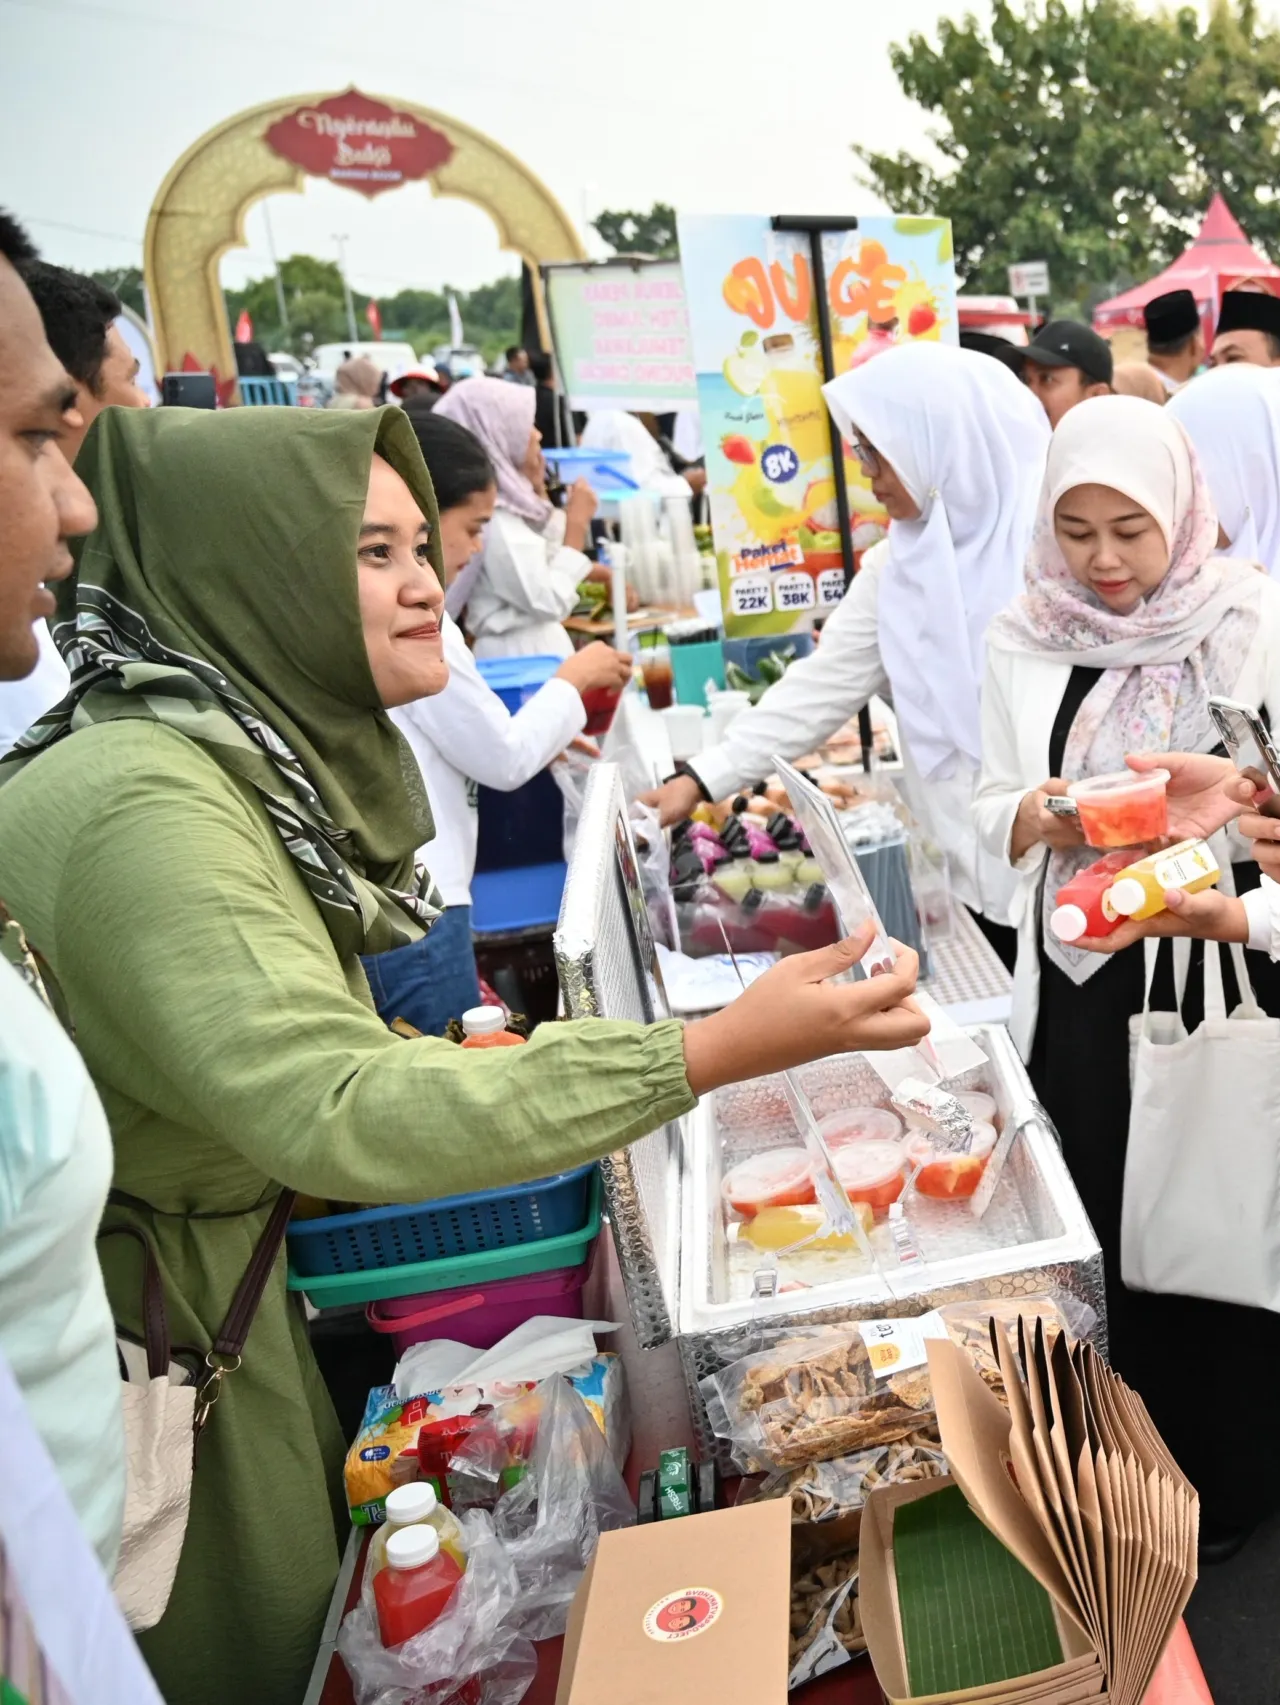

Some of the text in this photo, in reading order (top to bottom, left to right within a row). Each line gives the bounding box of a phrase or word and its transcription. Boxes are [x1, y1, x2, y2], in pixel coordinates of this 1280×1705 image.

[731, 252, 907, 329] JUCE
[765, 449, 795, 479] 8K
[740, 540, 787, 559] Paket
[738, 595, 768, 611] 22K
[782, 592, 810, 606] 38K
[664, 1486, 684, 1511] FRESH
